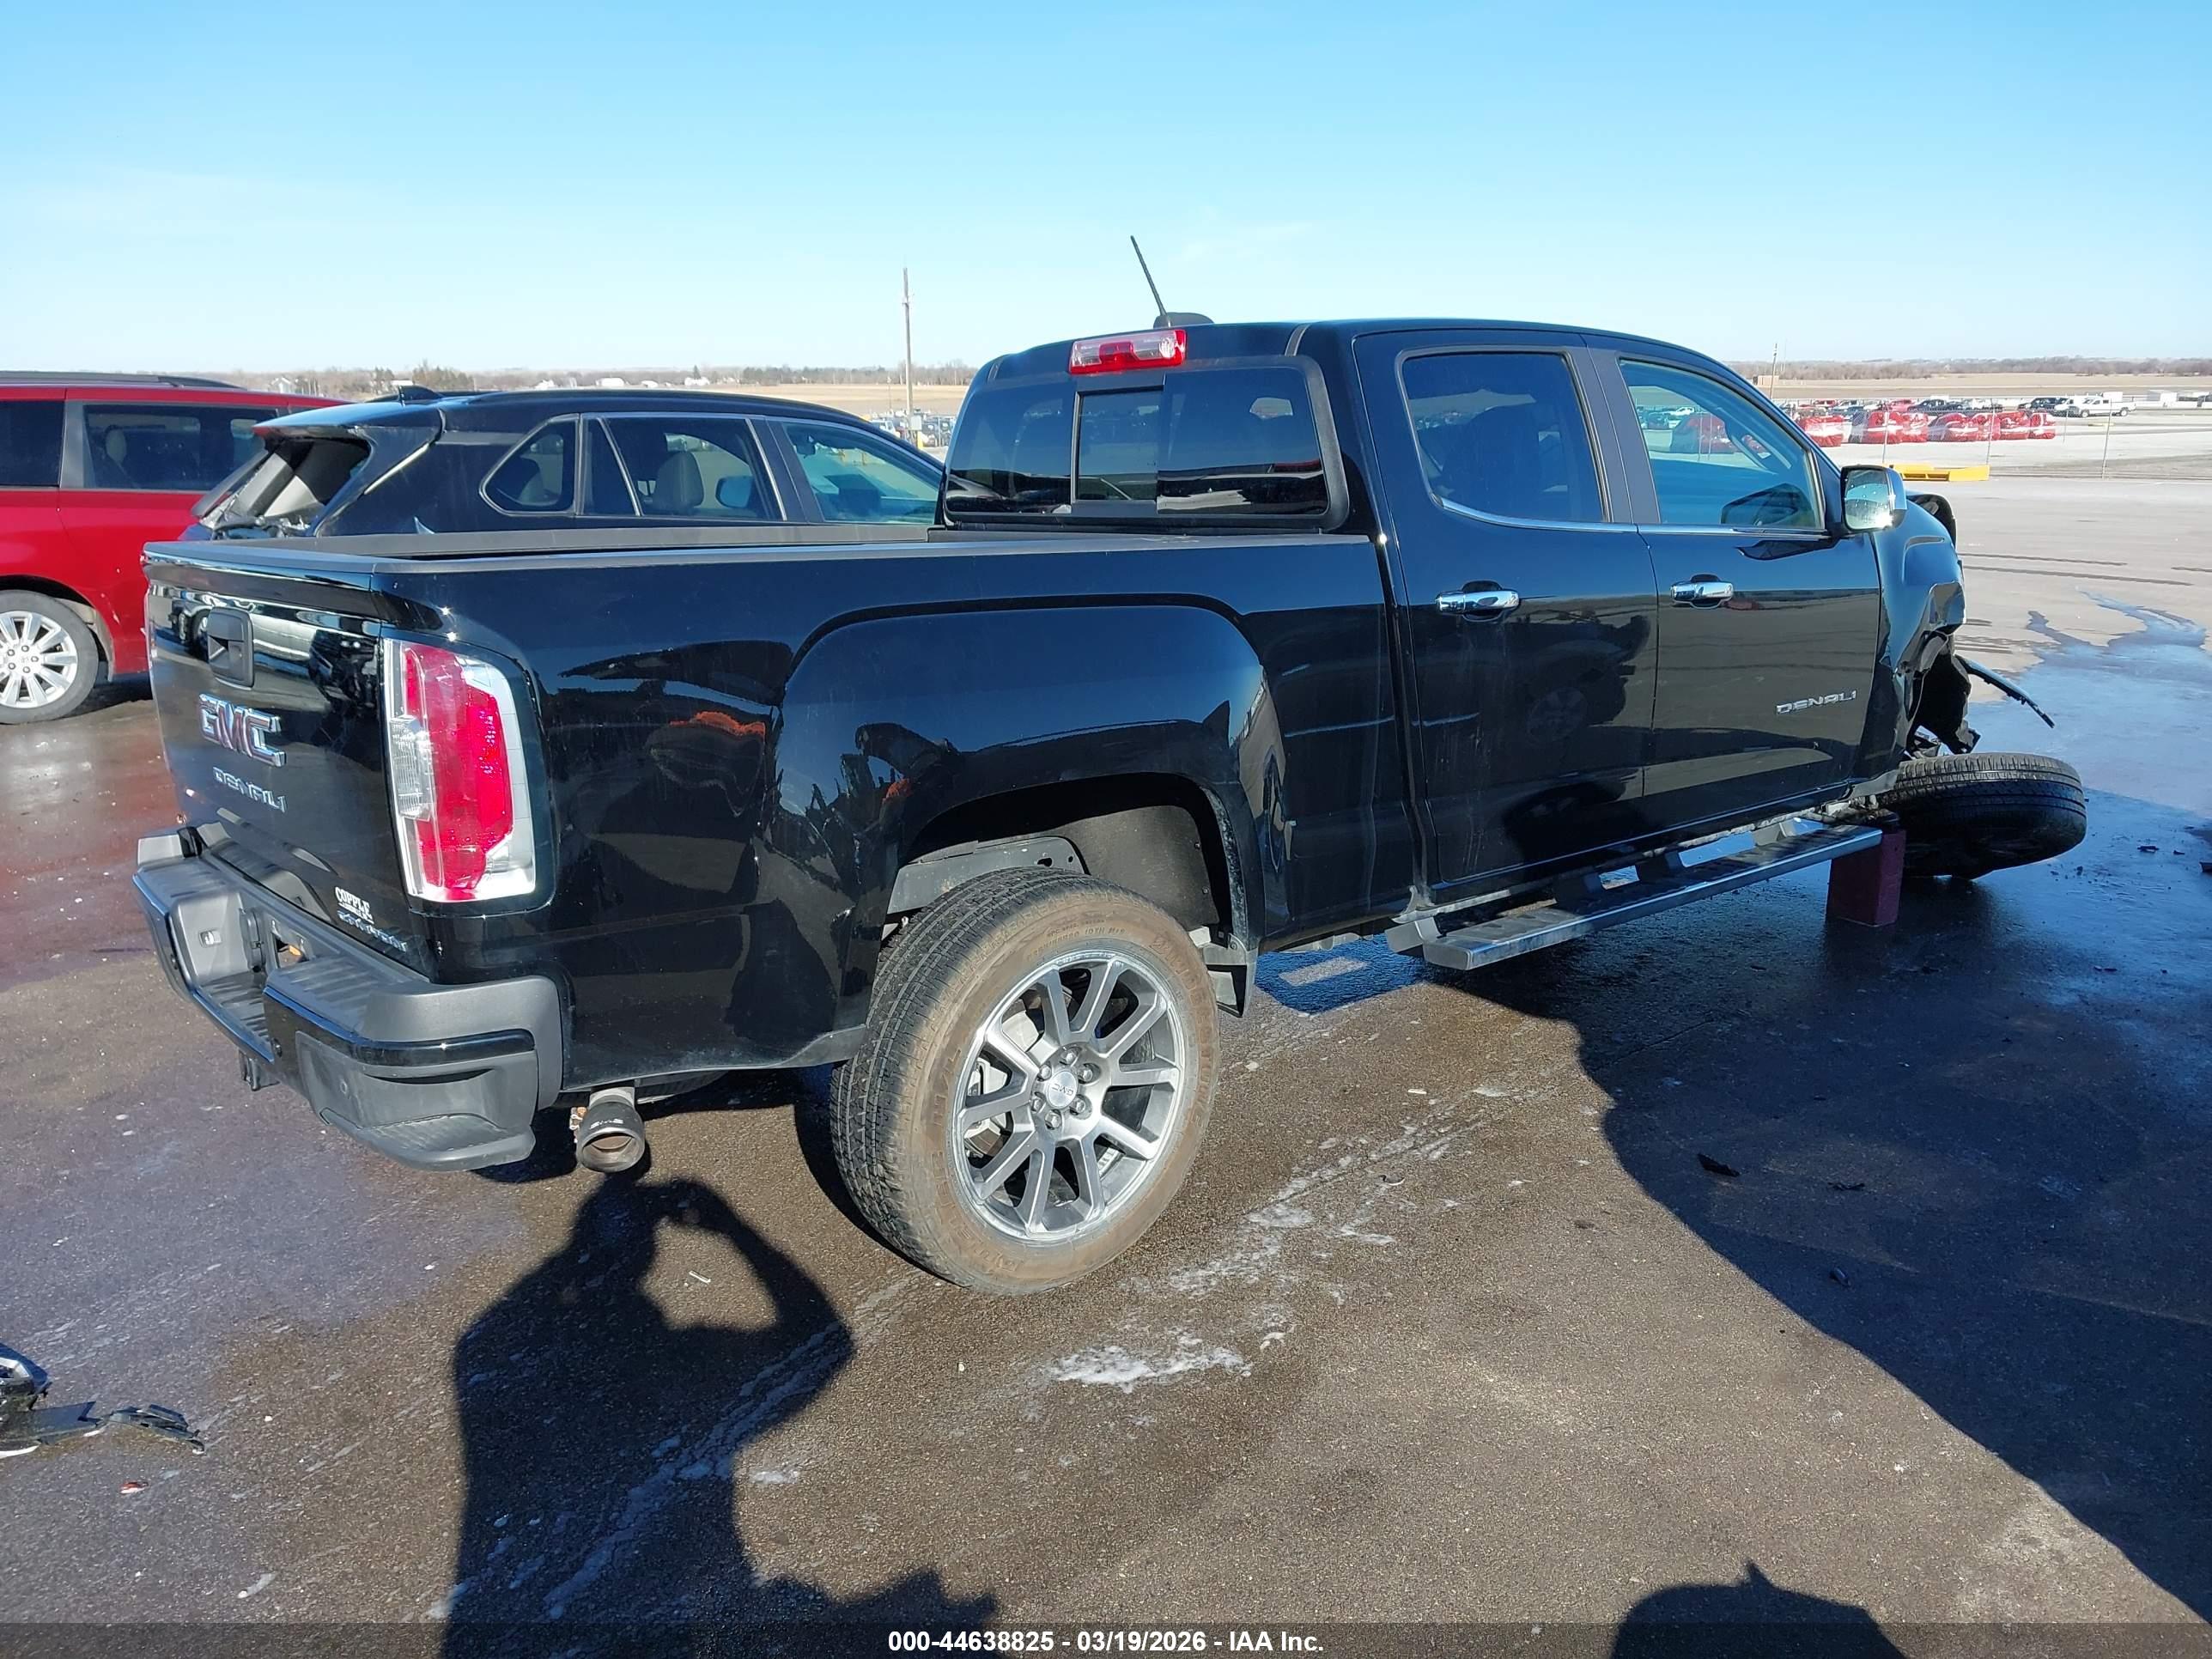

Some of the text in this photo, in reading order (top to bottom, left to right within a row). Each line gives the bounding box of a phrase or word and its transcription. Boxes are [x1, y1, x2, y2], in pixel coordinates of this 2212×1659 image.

[1776, 690, 1856, 714] DENALI
[199, 693, 287, 767] GMC
[213, 766, 288, 813] DENALI
[335, 886, 373, 921] COPPLE
[1051, 1083, 1074, 1097] GMC
